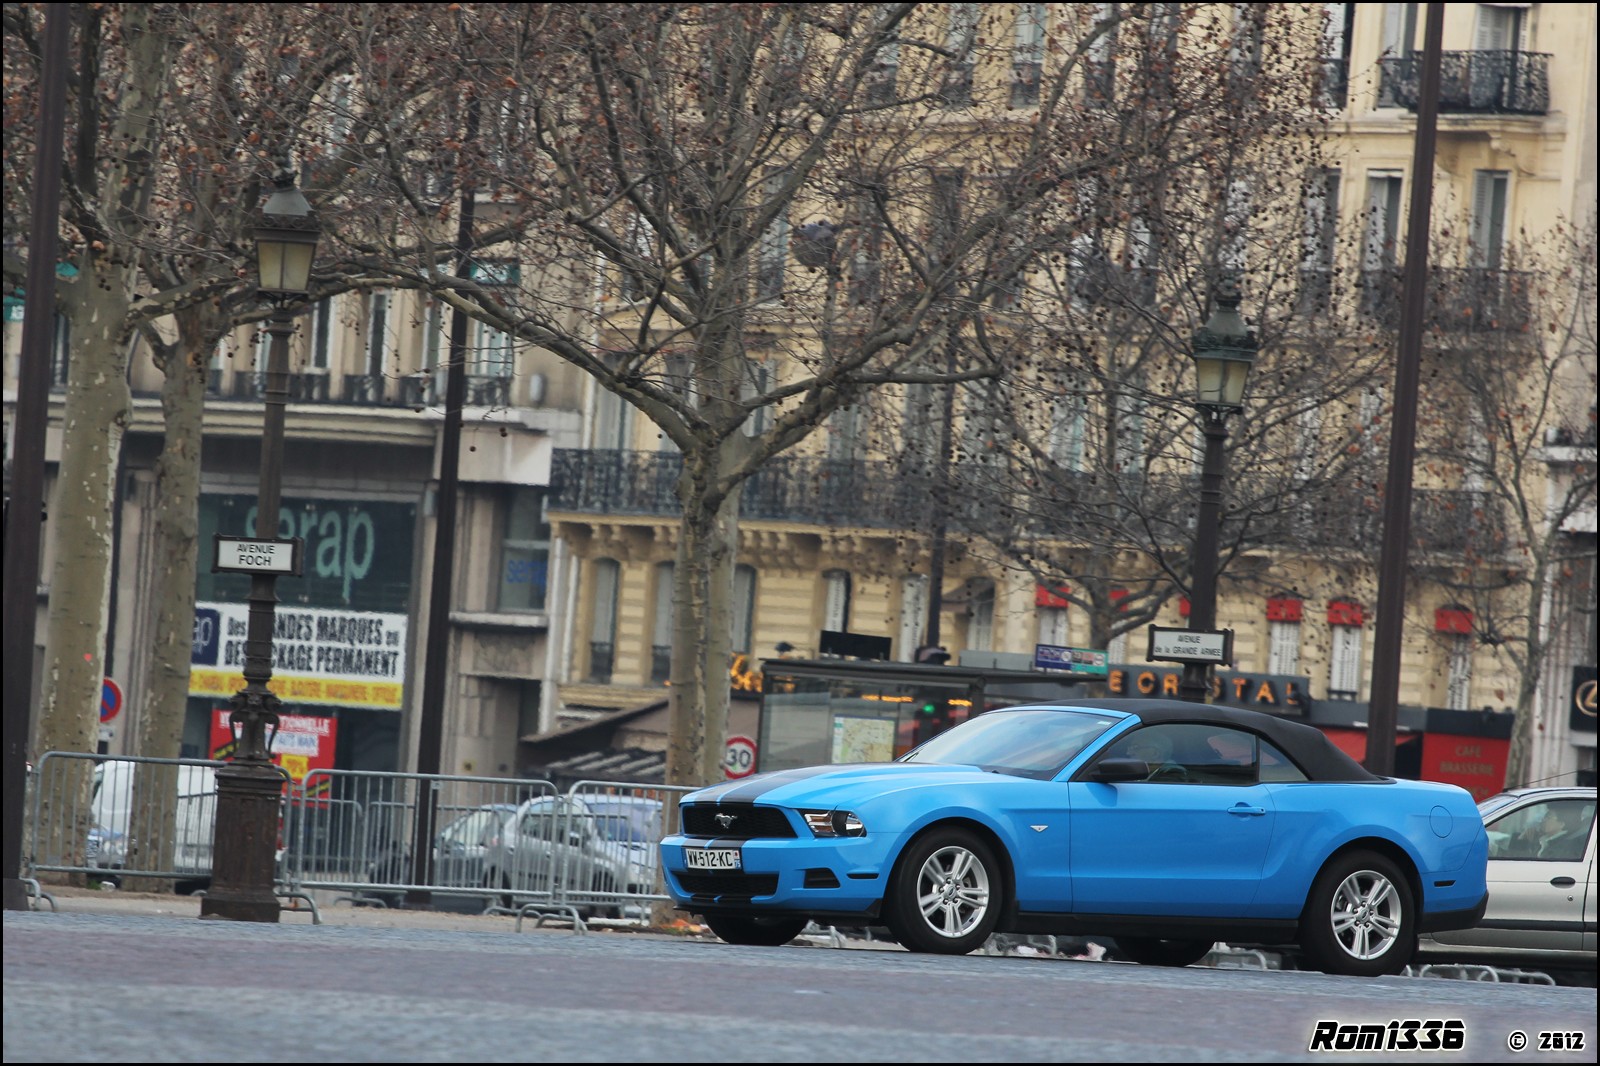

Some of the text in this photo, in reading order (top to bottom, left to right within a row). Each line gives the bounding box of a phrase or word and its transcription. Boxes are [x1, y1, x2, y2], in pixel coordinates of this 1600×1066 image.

[237, 543, 275, 554] AVENUE
[239, 554, 271, 566] FOCH
[316, 616, 383, 647] MARQUES
[1178, 635, 1201, 643] AVENUE
[1173, 646, 1198, 655] GRANDE
[316, 646, 399, 678] PERMANENT
[726, 748, 751, 768] 30
